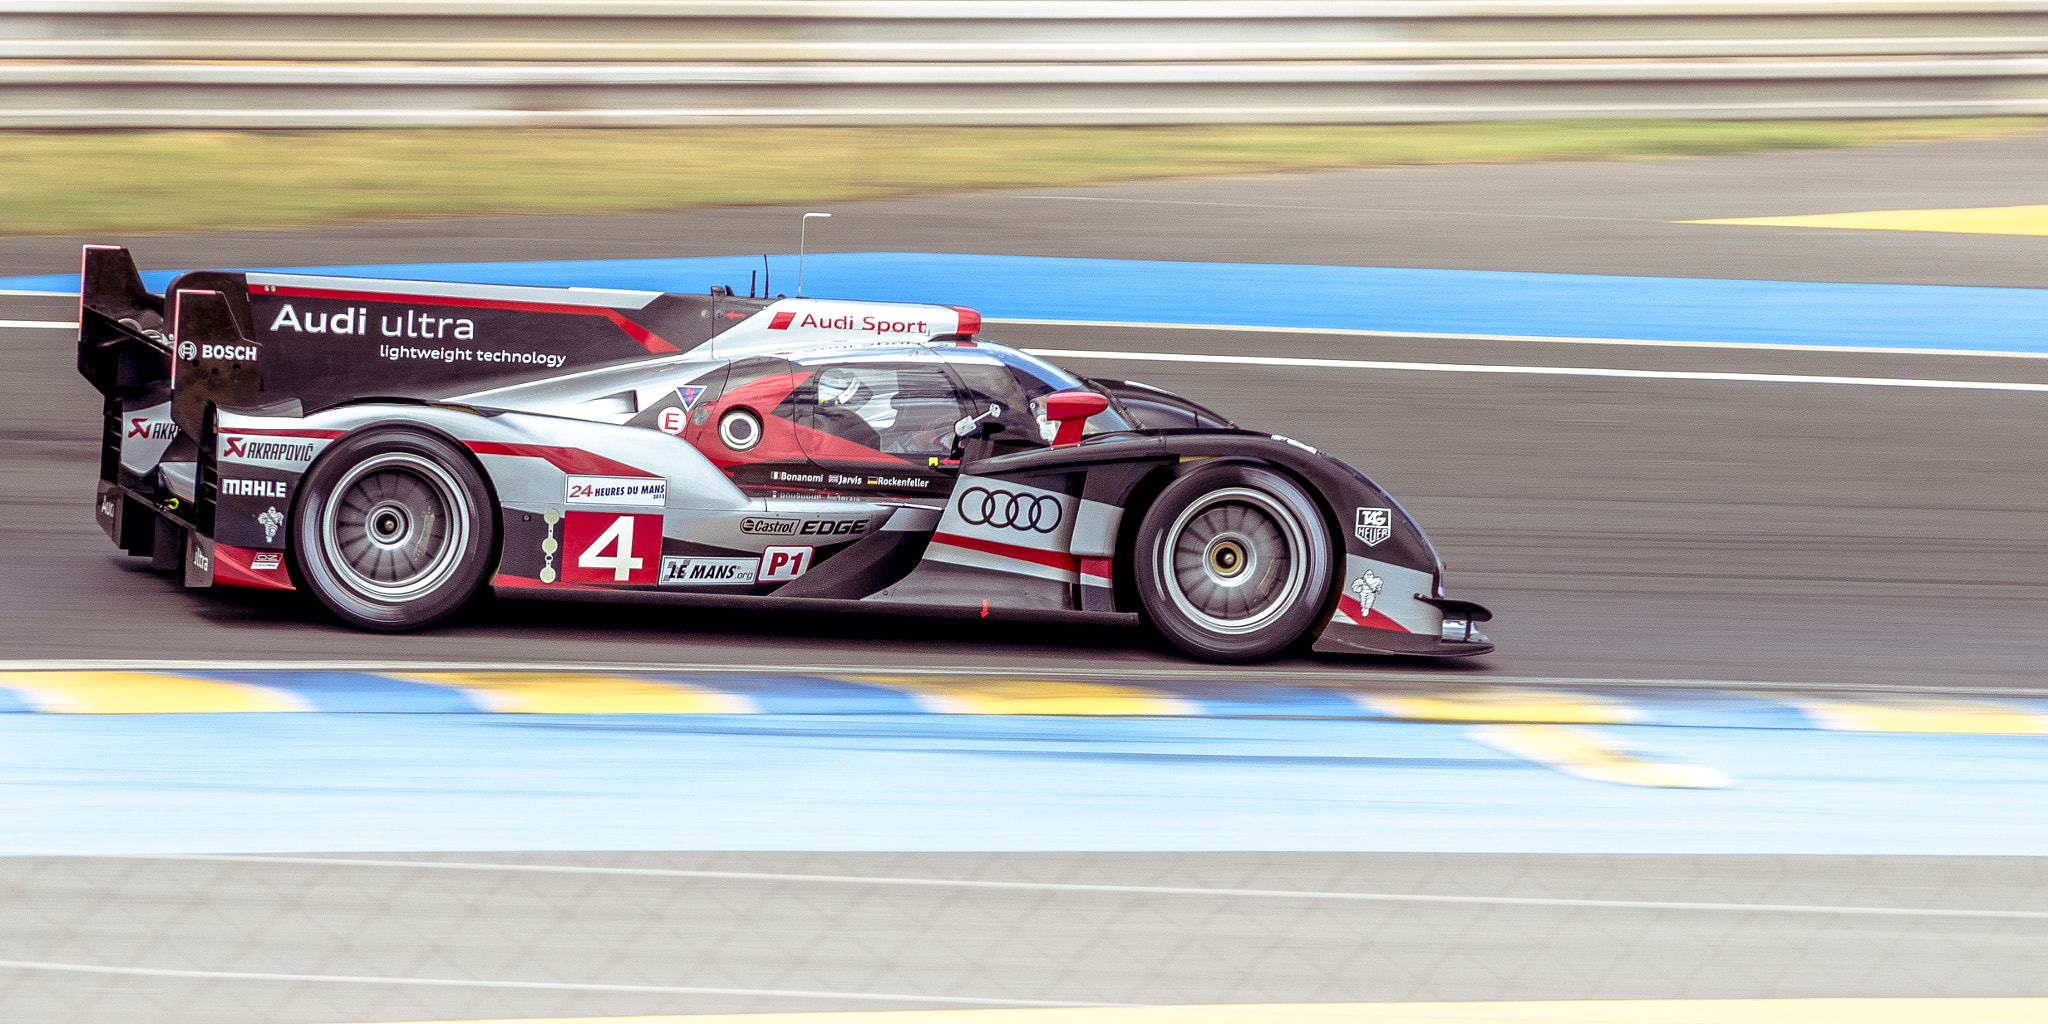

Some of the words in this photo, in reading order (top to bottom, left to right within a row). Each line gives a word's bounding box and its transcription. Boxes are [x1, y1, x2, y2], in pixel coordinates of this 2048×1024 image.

[270, 303, 367, 337] Audi
[381, 309, 475, 340] ultra
[800, 313, 854, 330] Audi
[861, 316, 928, 335] Sport
[202, 344, 257, 361] BOSCH
[379, 344, 473, 363] lightweight
[475, 349, 567, 368] technology
[664, 412, 680, 431] E
[152, 422, 179, 440] AKR
[222, 478, 287, 498] MAHLE
[780, 471, 824, 482] Bonanomi
[838, 475, 863, 485] Jarvis
[877, 476, 929, 488] Rockenfeller
[569, 485, 592, 498] 24
[594, 486, 625, 497] HEURES
[627, 486, 639, 495] DU
[640, 484, 665, 494] MANS
[754, 519, 794, 534] Castrol
[801, 519, 870, 535] EDGE
[1362, 510, 1387, 526] TAG
[1358, 526, 1388, 543] HEUER
[578, 515, 644, 581] 4
[669, 564, 687, 579] LE
[767, 552, 804, 576] P1
